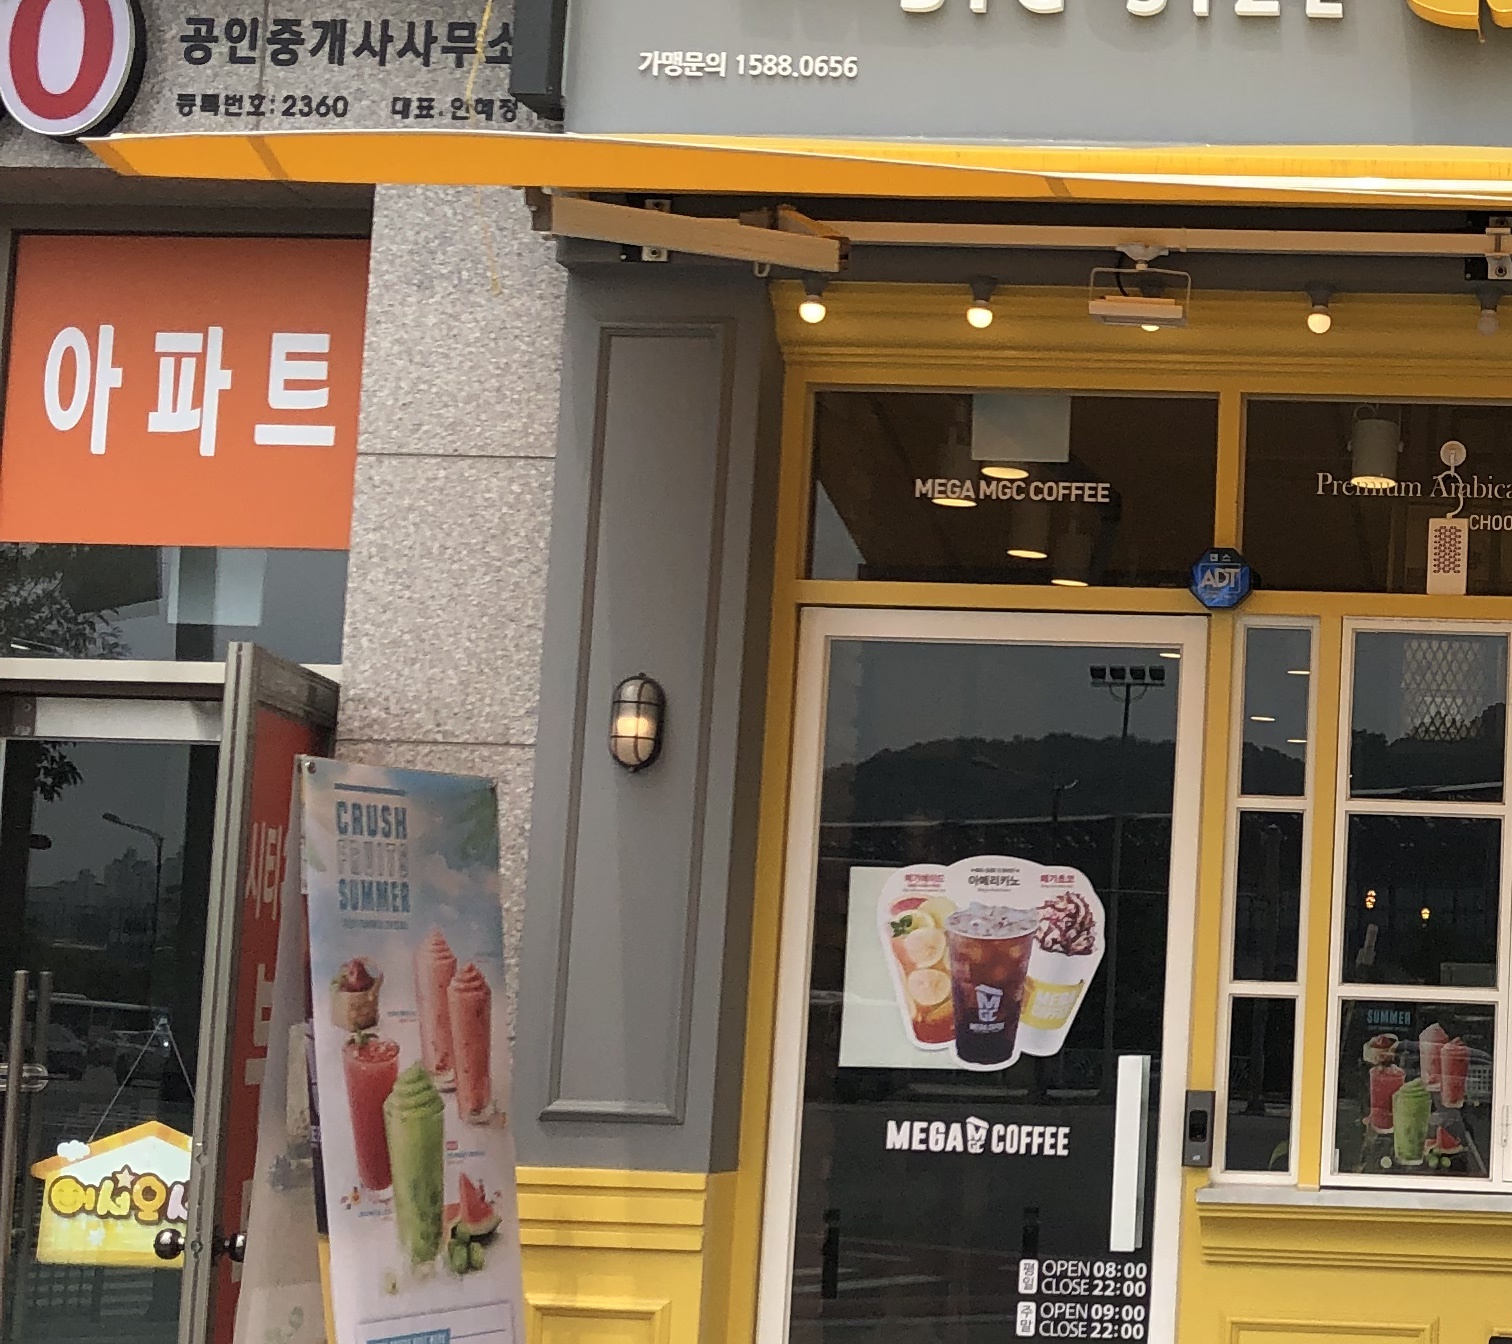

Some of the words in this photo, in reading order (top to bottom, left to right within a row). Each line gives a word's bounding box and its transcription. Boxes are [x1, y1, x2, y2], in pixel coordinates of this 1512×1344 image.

[638, 50, 727, 77] 가맹문의
[735, 54, 859, 78] 1588.0656
[44, 325, 336, 457] 아파트
[915, 478, 976, 500] MEGA
[979, 479, 1026, 501] MGC
[1029, 480, 1111, 503] COFFEE
[1316, 471, 1422, 499] Premium
[1200, 567, 1242, 588] ADT
[335, 801, 408, 840] CRUSH
[337, 878, 411, 913] SUMMER
[1367, 1009, 1411, 1025] SUMMER
[885, 1120, 964, 1153] MEGA
[991, 1124, 1071, 1156] COFFEE
[1042, 1260, 1090, 1279] OPEN
[1093, 1261, 1147, 1280] 08:00
[1041, 1278, 1090, 1296] CLOSE
[1092, 1280, 1146, 1298] 22:00
[1040, 1302, 1088, 1320] OPEN
[1091, 1304, 1145, 1322] 09:00
[1039, 1320, 1087, 1338] CLOSE
[1090, 1321, 1144, 1340] 22:00
